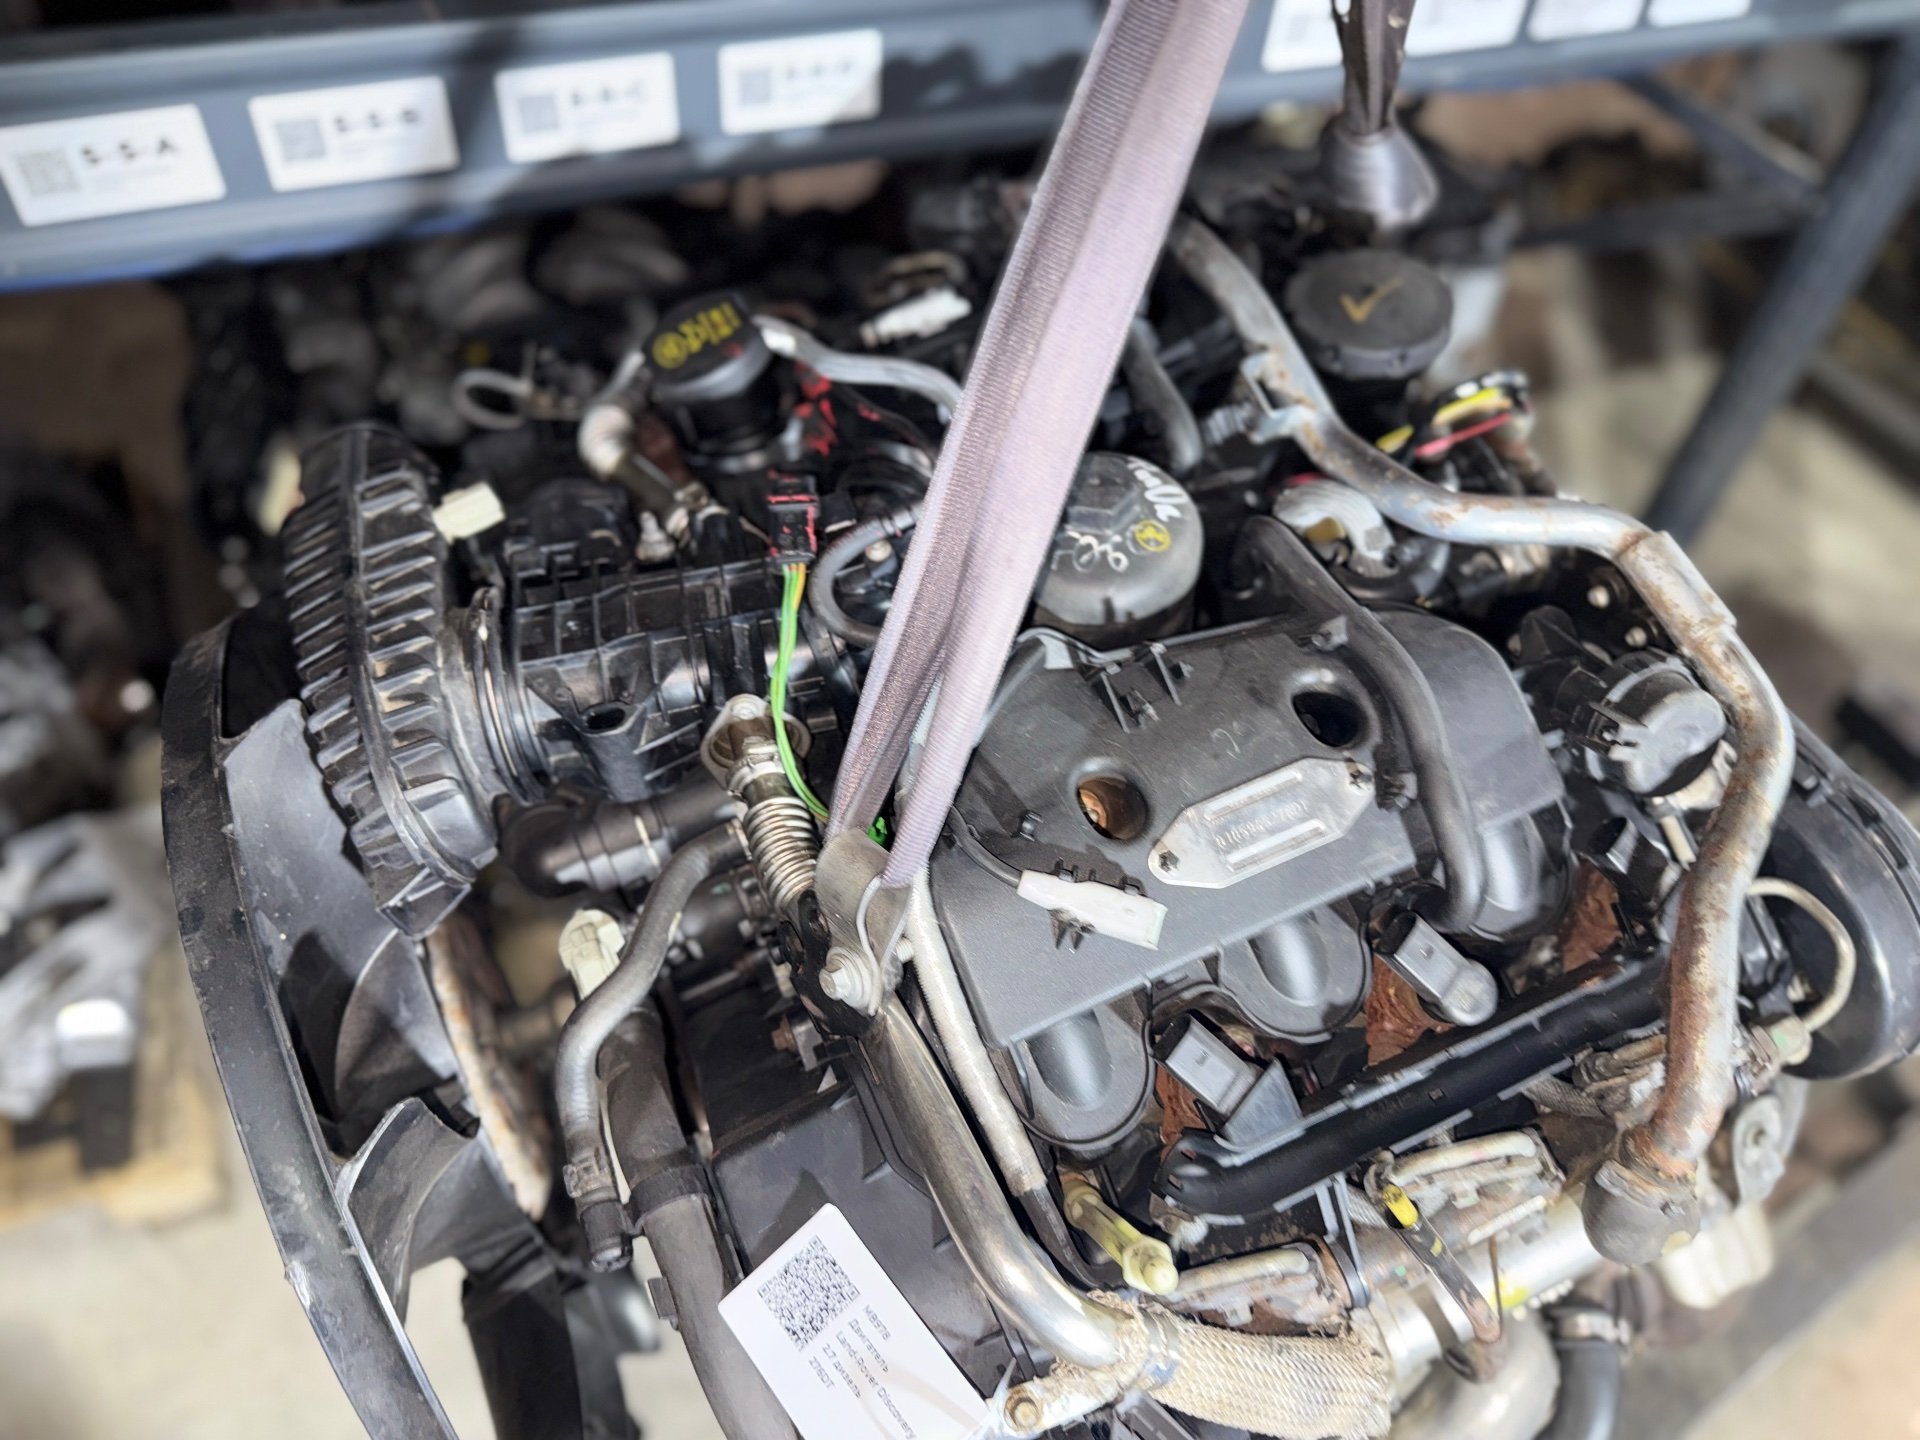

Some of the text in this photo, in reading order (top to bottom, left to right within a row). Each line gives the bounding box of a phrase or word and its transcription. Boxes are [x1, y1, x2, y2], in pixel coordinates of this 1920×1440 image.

[849, 1318, 888, 1372] Двигатель
[833, 1360, 862, 1398] дизель
[836, 1330, 916, 1440] Land-Rover Discovery
